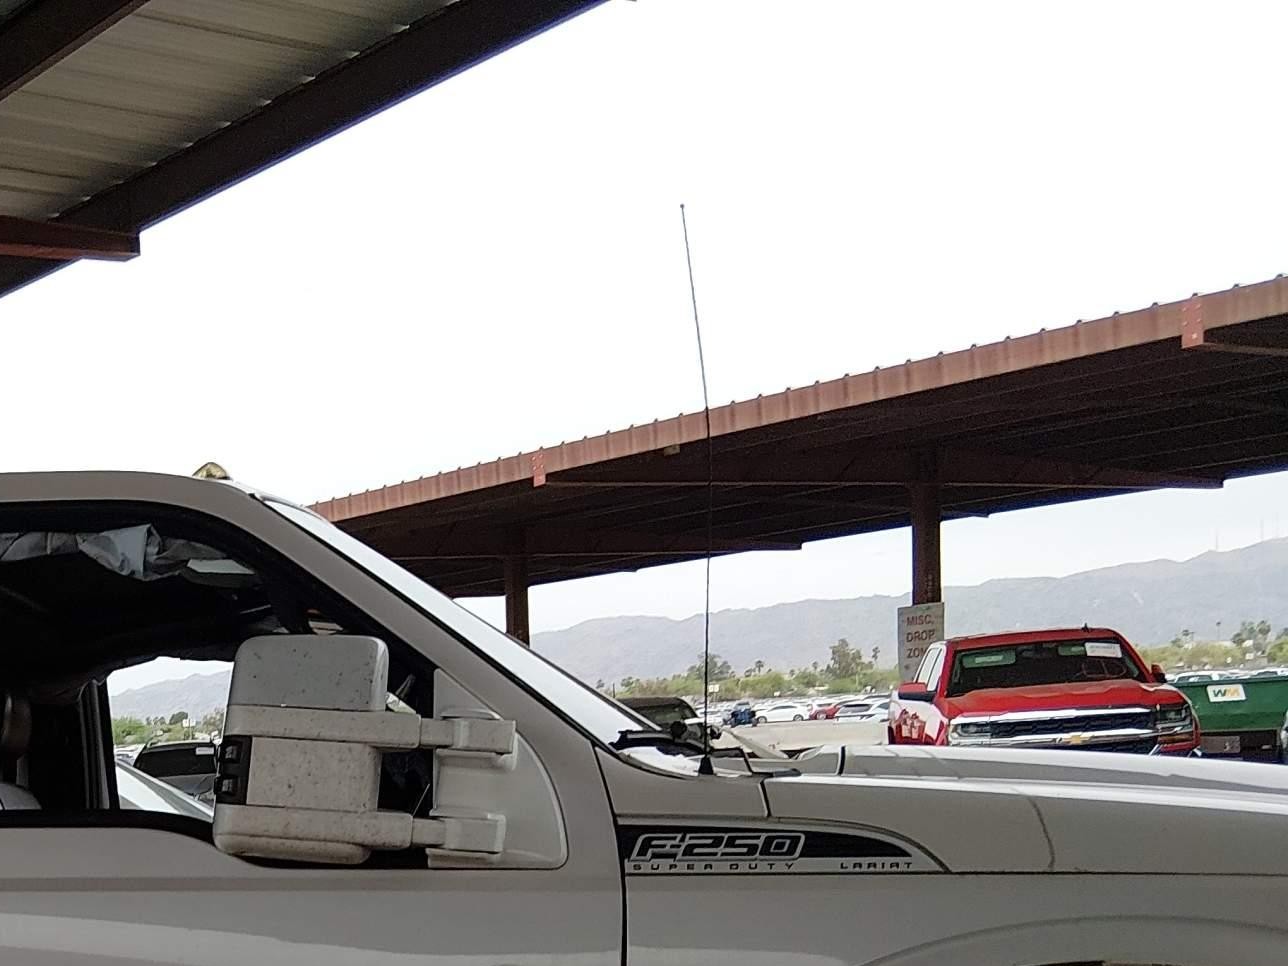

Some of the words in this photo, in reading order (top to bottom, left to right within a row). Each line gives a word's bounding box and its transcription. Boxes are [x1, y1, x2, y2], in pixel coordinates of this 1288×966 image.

[906, 629, 936, 642] DROP
[906, 647, 928, 659] ZON
[1213, 686, 1241, 697] WM
[633, 863, 713, 871] SUPER
[729, 863, 794, 871] DUTY
[839, 862, 913, 870] LARIAT
